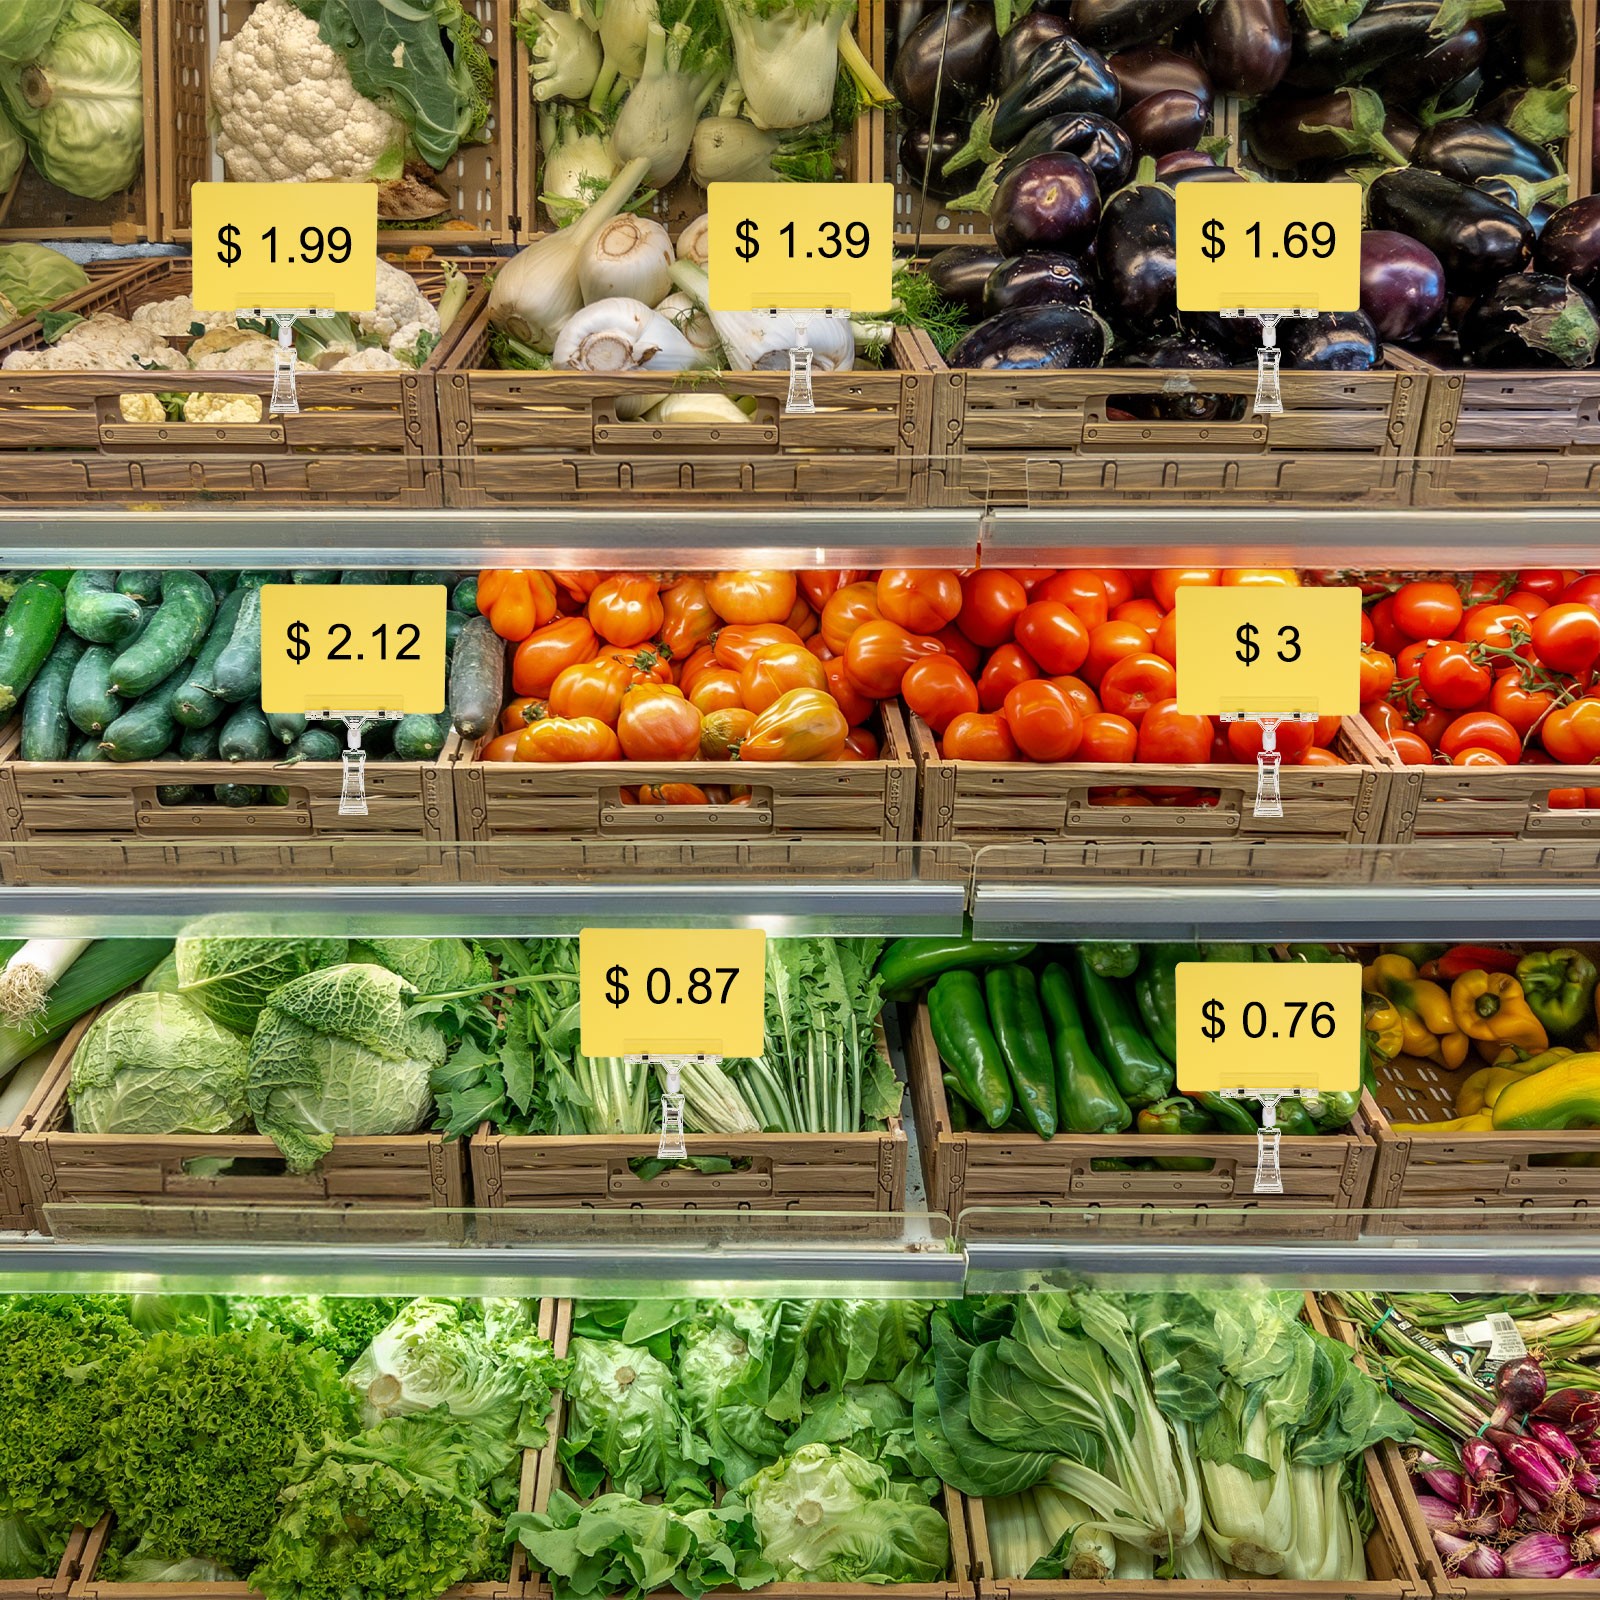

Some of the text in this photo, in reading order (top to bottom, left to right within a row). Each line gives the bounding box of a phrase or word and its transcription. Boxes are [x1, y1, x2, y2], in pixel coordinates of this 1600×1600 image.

[218, 224, 352, 268] $ 1.99
[736, 218, 870, 262] $ 1.39
[1202, 218, 1336, 262] $ 1.69
[287, 620, 420, 665] $ 2.12
[1236, 623, 1301, 666] $ 3
[606, 965, 739, 1008] $ 0.87
[1202, 999, 1336, 1042] $ 0.76
